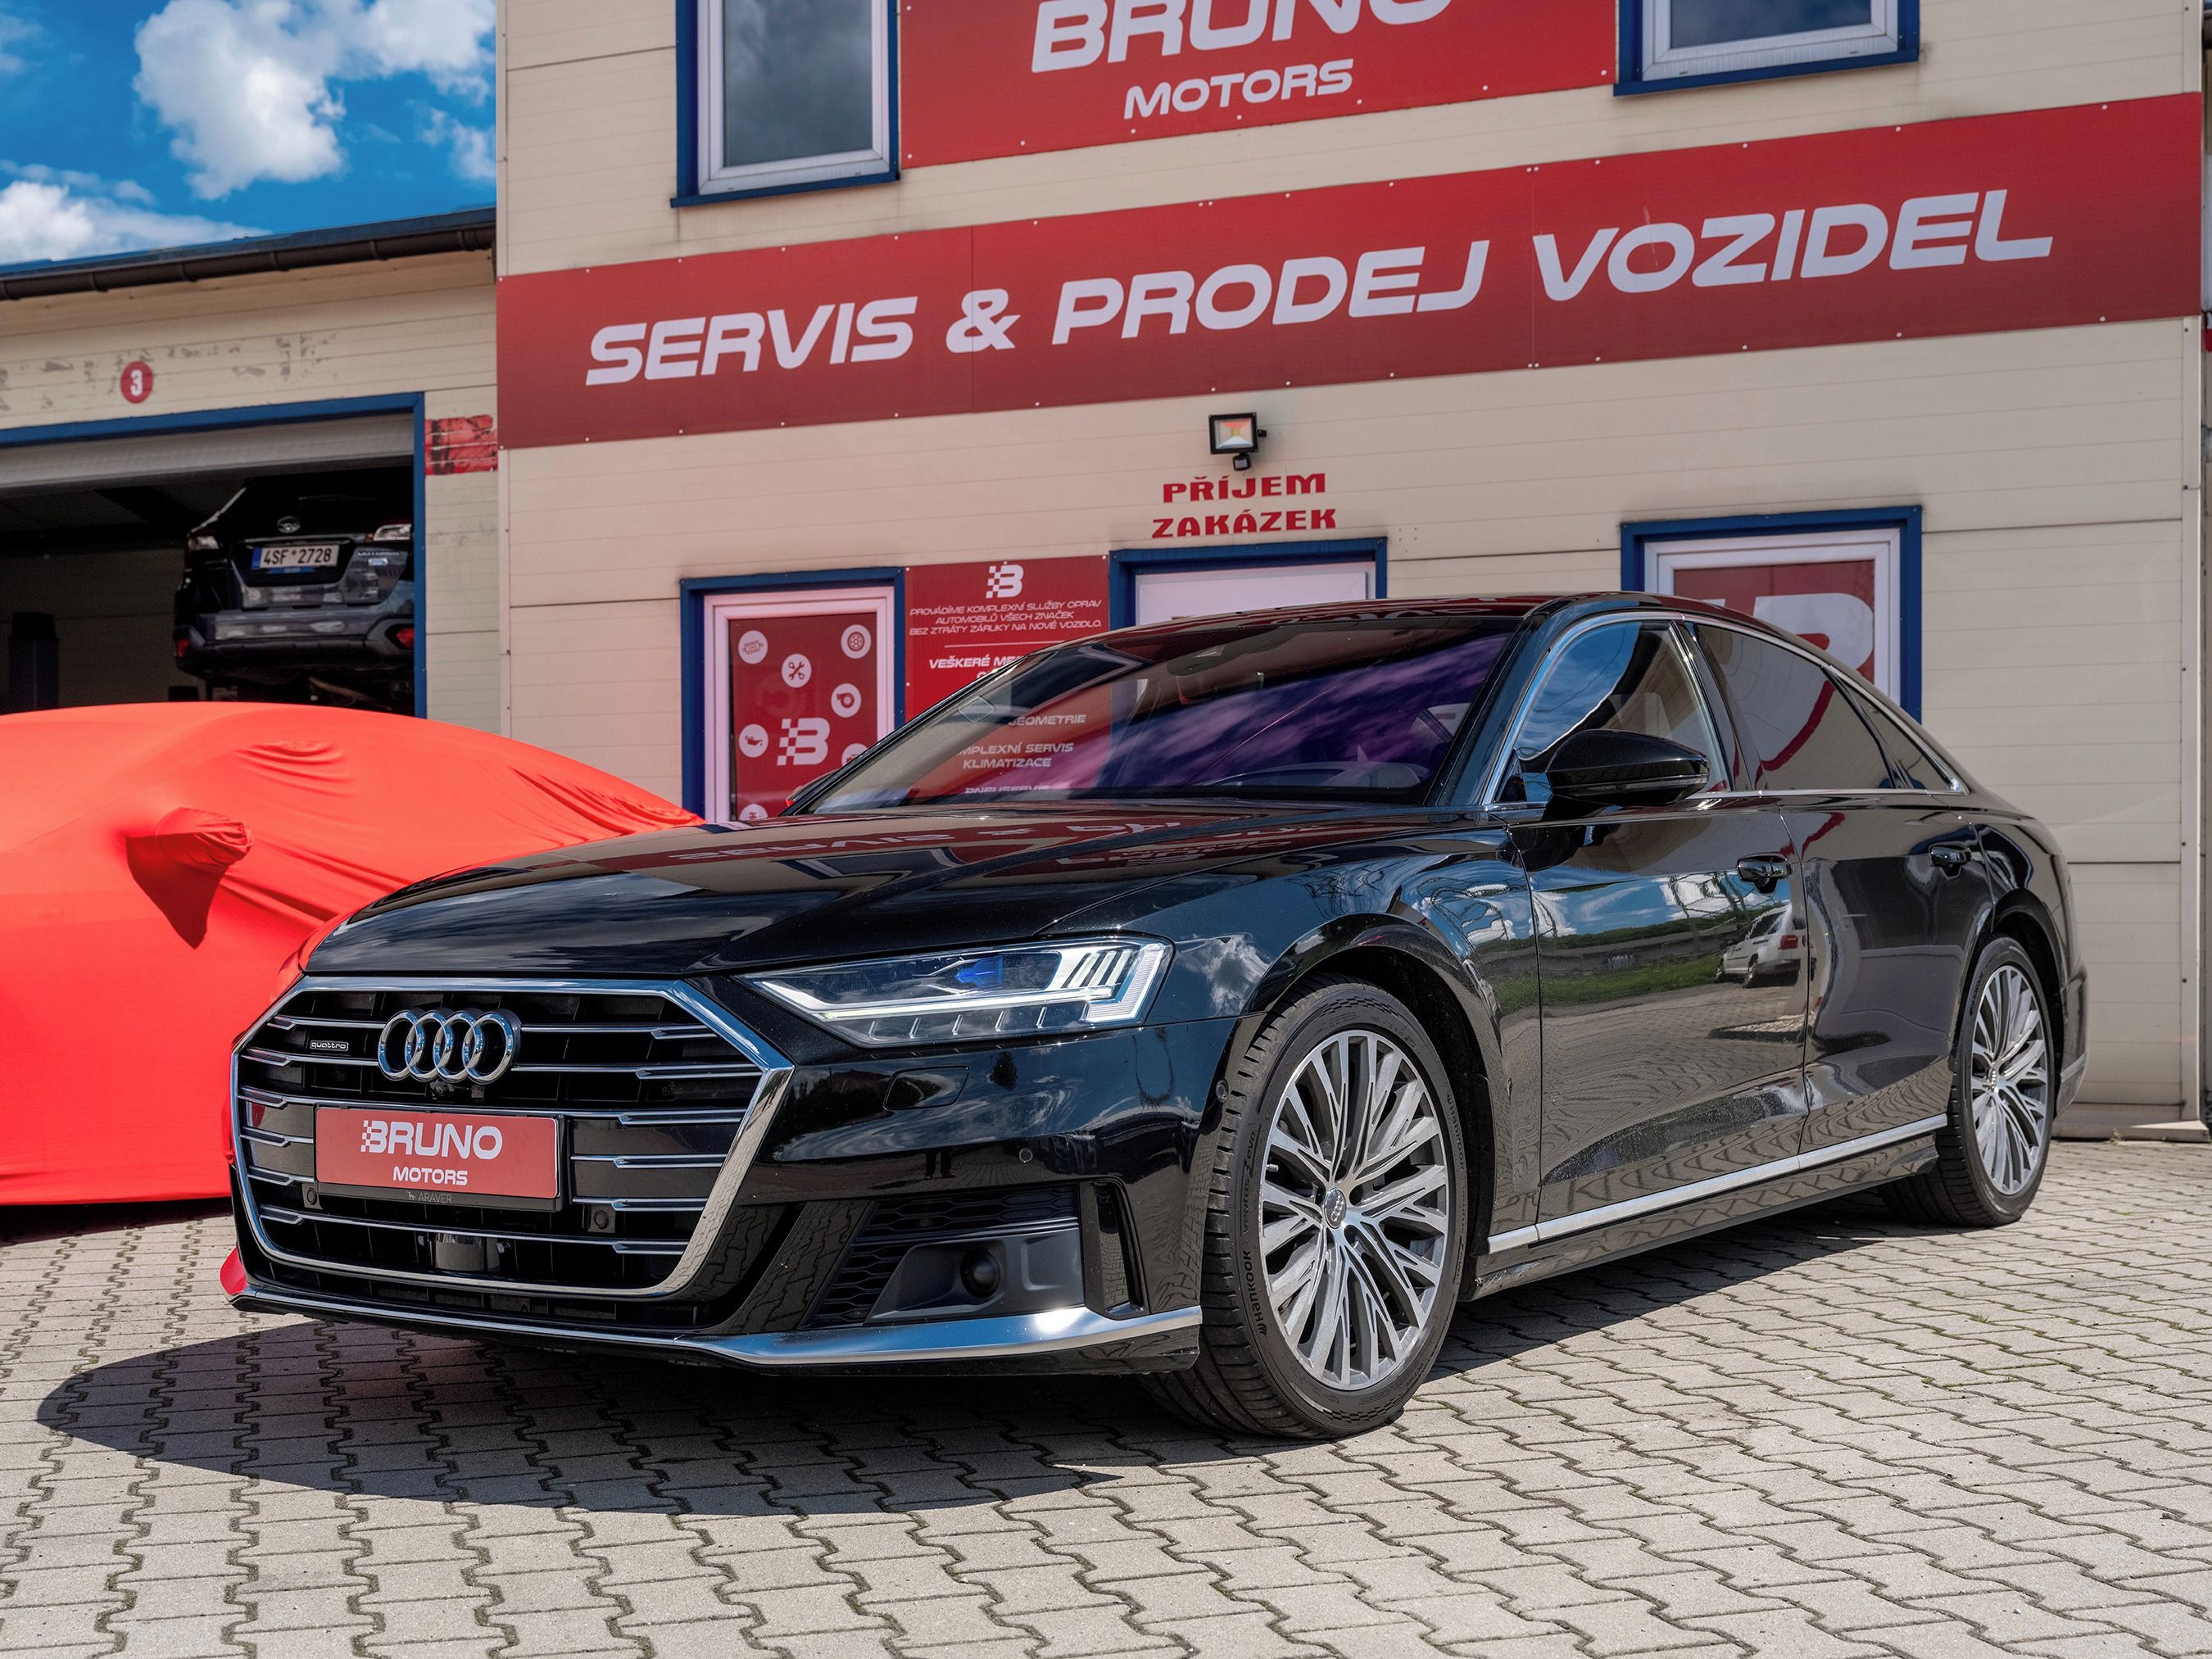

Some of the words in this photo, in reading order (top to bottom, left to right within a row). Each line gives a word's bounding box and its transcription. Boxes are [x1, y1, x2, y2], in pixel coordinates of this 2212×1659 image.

[1123, 58, 1354, 120] MOTORS
[585, 296, 918, 386] SERVIS
[945, 288, 1021, 353] &
[1052, 240, 1490, 345] PRODEJ
[1531, 188, 2054, 301] VOZIDEL
[129, 369, 143, 396] 3
[1163, 473, 1326, 504] PŘÍJEM
[1152, 509, 1336, 538] ZAKÁZEK
[910, 605, 965, 616] PROVÁDÍME
[967, 601, 1026, 614] KOMPLEXNÍ
[1027, 600, 1064, 610] SLUŽBY
[1067, 600, 1102, 609] OPRAV
[1000, 612, 1032, 622] VŠECH
[1034, 610, 1074, 620] ZNAČEK
[909, 627, 928, 636] BEZ
[930, 624, 967, 635] ZTRÁTY
[969, 623, 1010, 632] ZÁRUKY
[1011, 623, 1027, 632] NA
[1029, 620, 1057, 630] NOVÉ
[929, 655, 990, 669] VEŠKERÉ
[1026, 743, 1074, 754] SERVIS
[963, 757, 1052, 769] KLIMATIZACE
[360, 1119, 503, 1160] BRUNO
[392, 1166, 469, 1185] MOTORS
[418, 1192, 453, 1203] ARAVER
